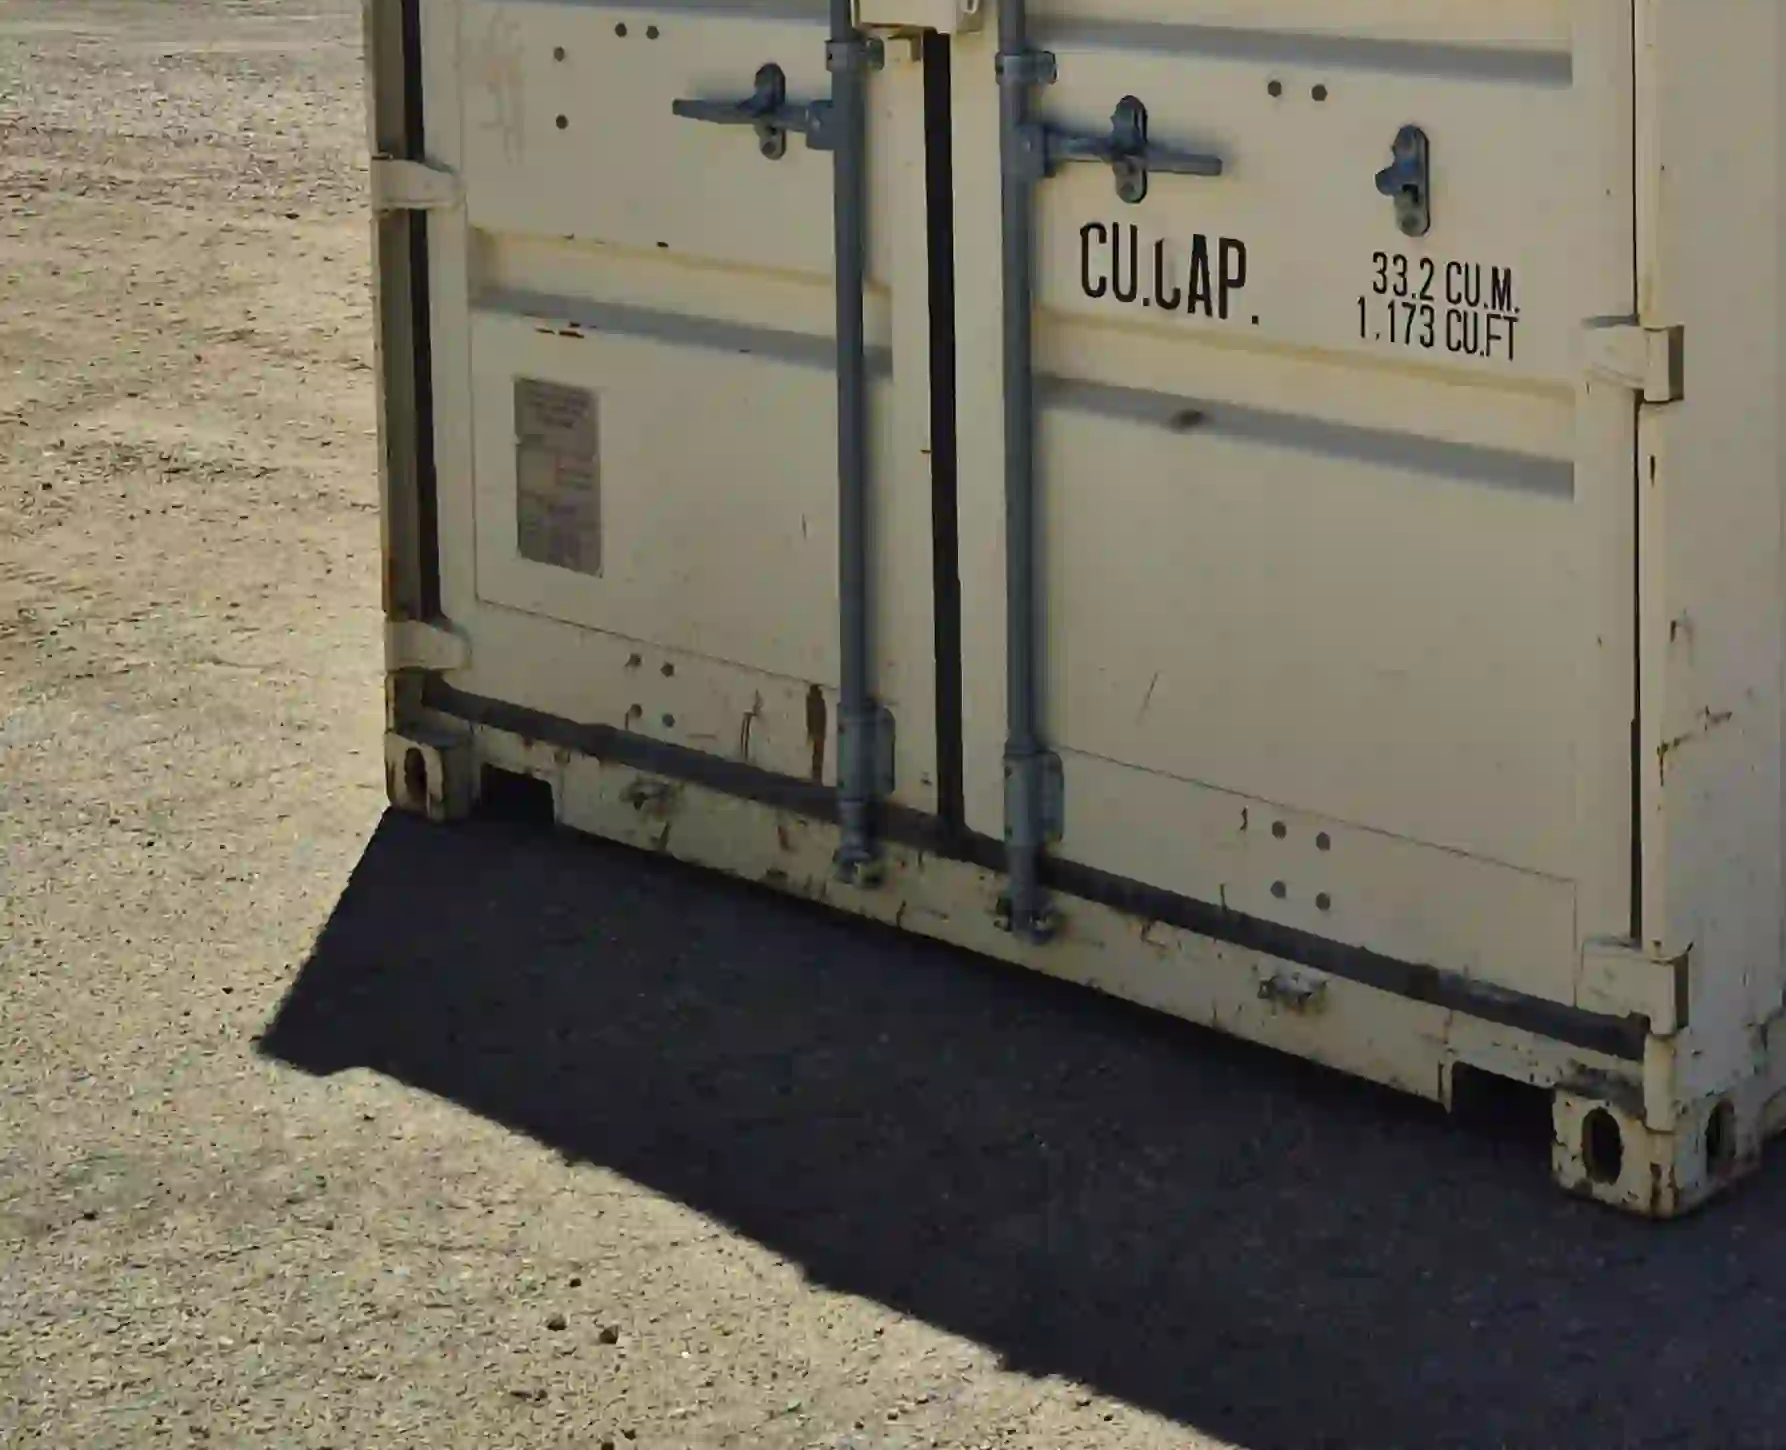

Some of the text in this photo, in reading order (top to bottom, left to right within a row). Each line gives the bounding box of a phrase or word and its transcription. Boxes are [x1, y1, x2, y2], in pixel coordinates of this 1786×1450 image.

[1372, 250, 1520, 314] 33.2 CU.M.
[1357, 295, 1519, 362] 1,173 CU.FT
